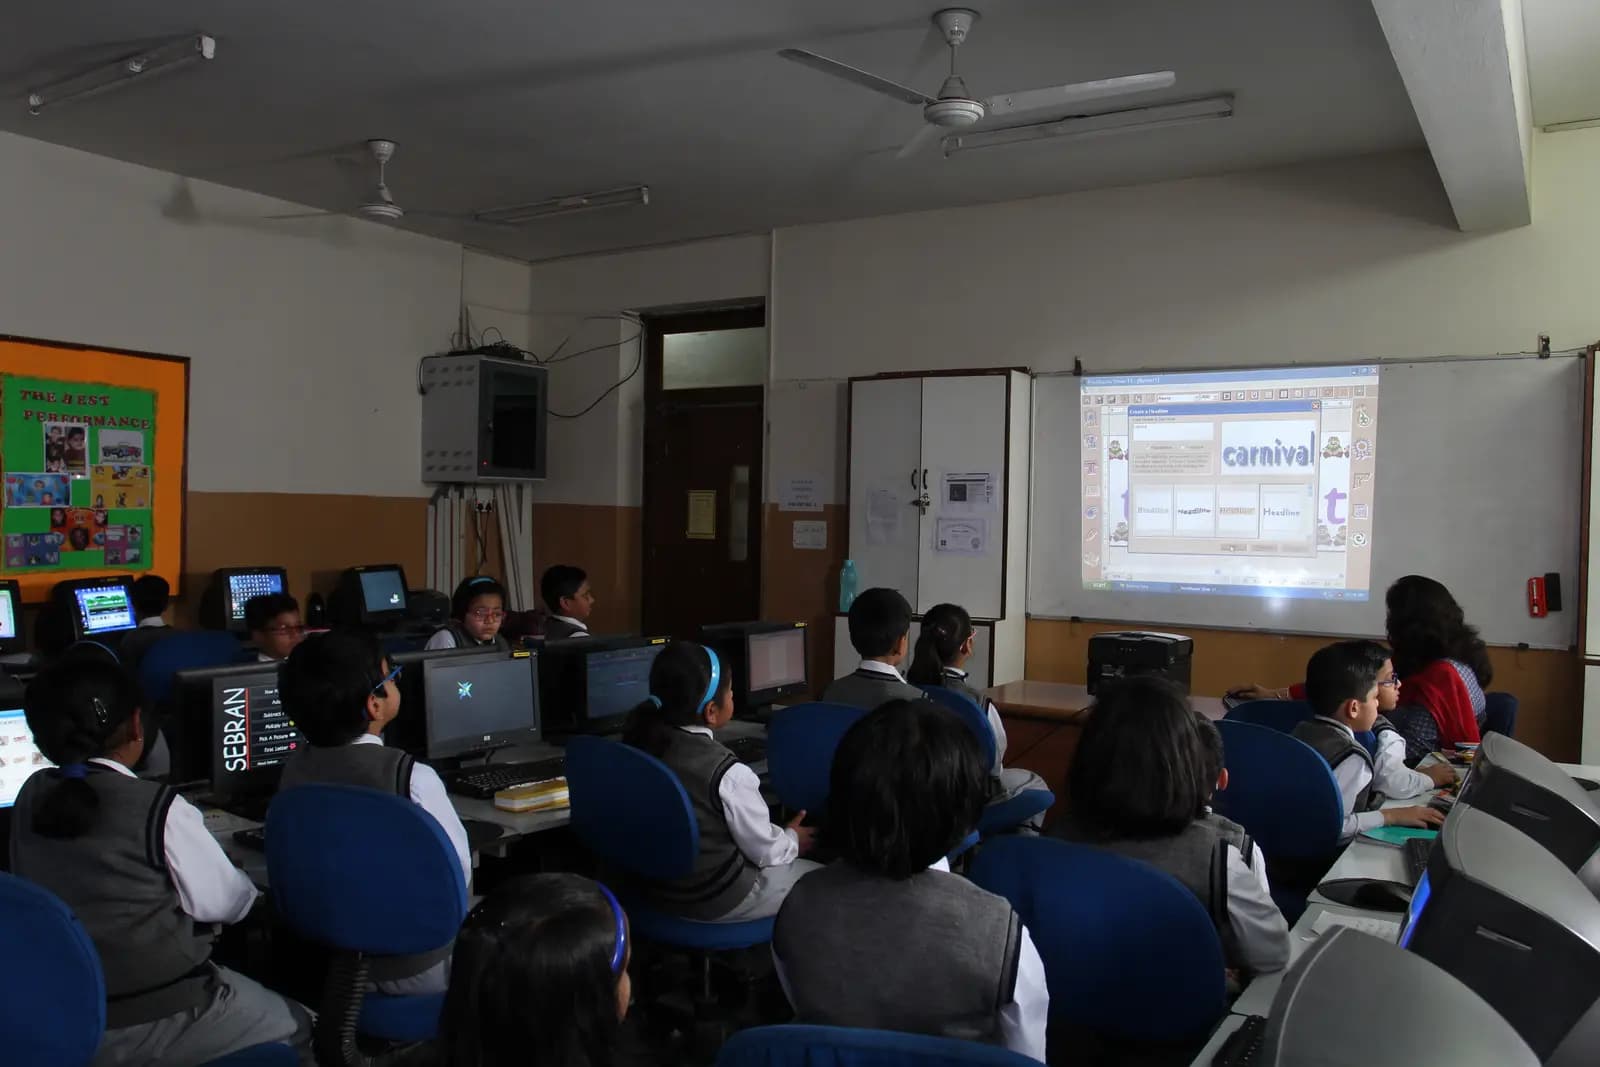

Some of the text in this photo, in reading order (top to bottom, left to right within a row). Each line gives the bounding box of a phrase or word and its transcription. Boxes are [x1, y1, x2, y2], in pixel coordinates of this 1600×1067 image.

[20, 390, 110, 406] THE BEST
[23, 409, 151, 430] PERFORMANCE
[1222, 430, 1315, 468] carnival
[1263, 507, 1301, 517] Headline
[223, 687, 247, 771] SEBRAN
